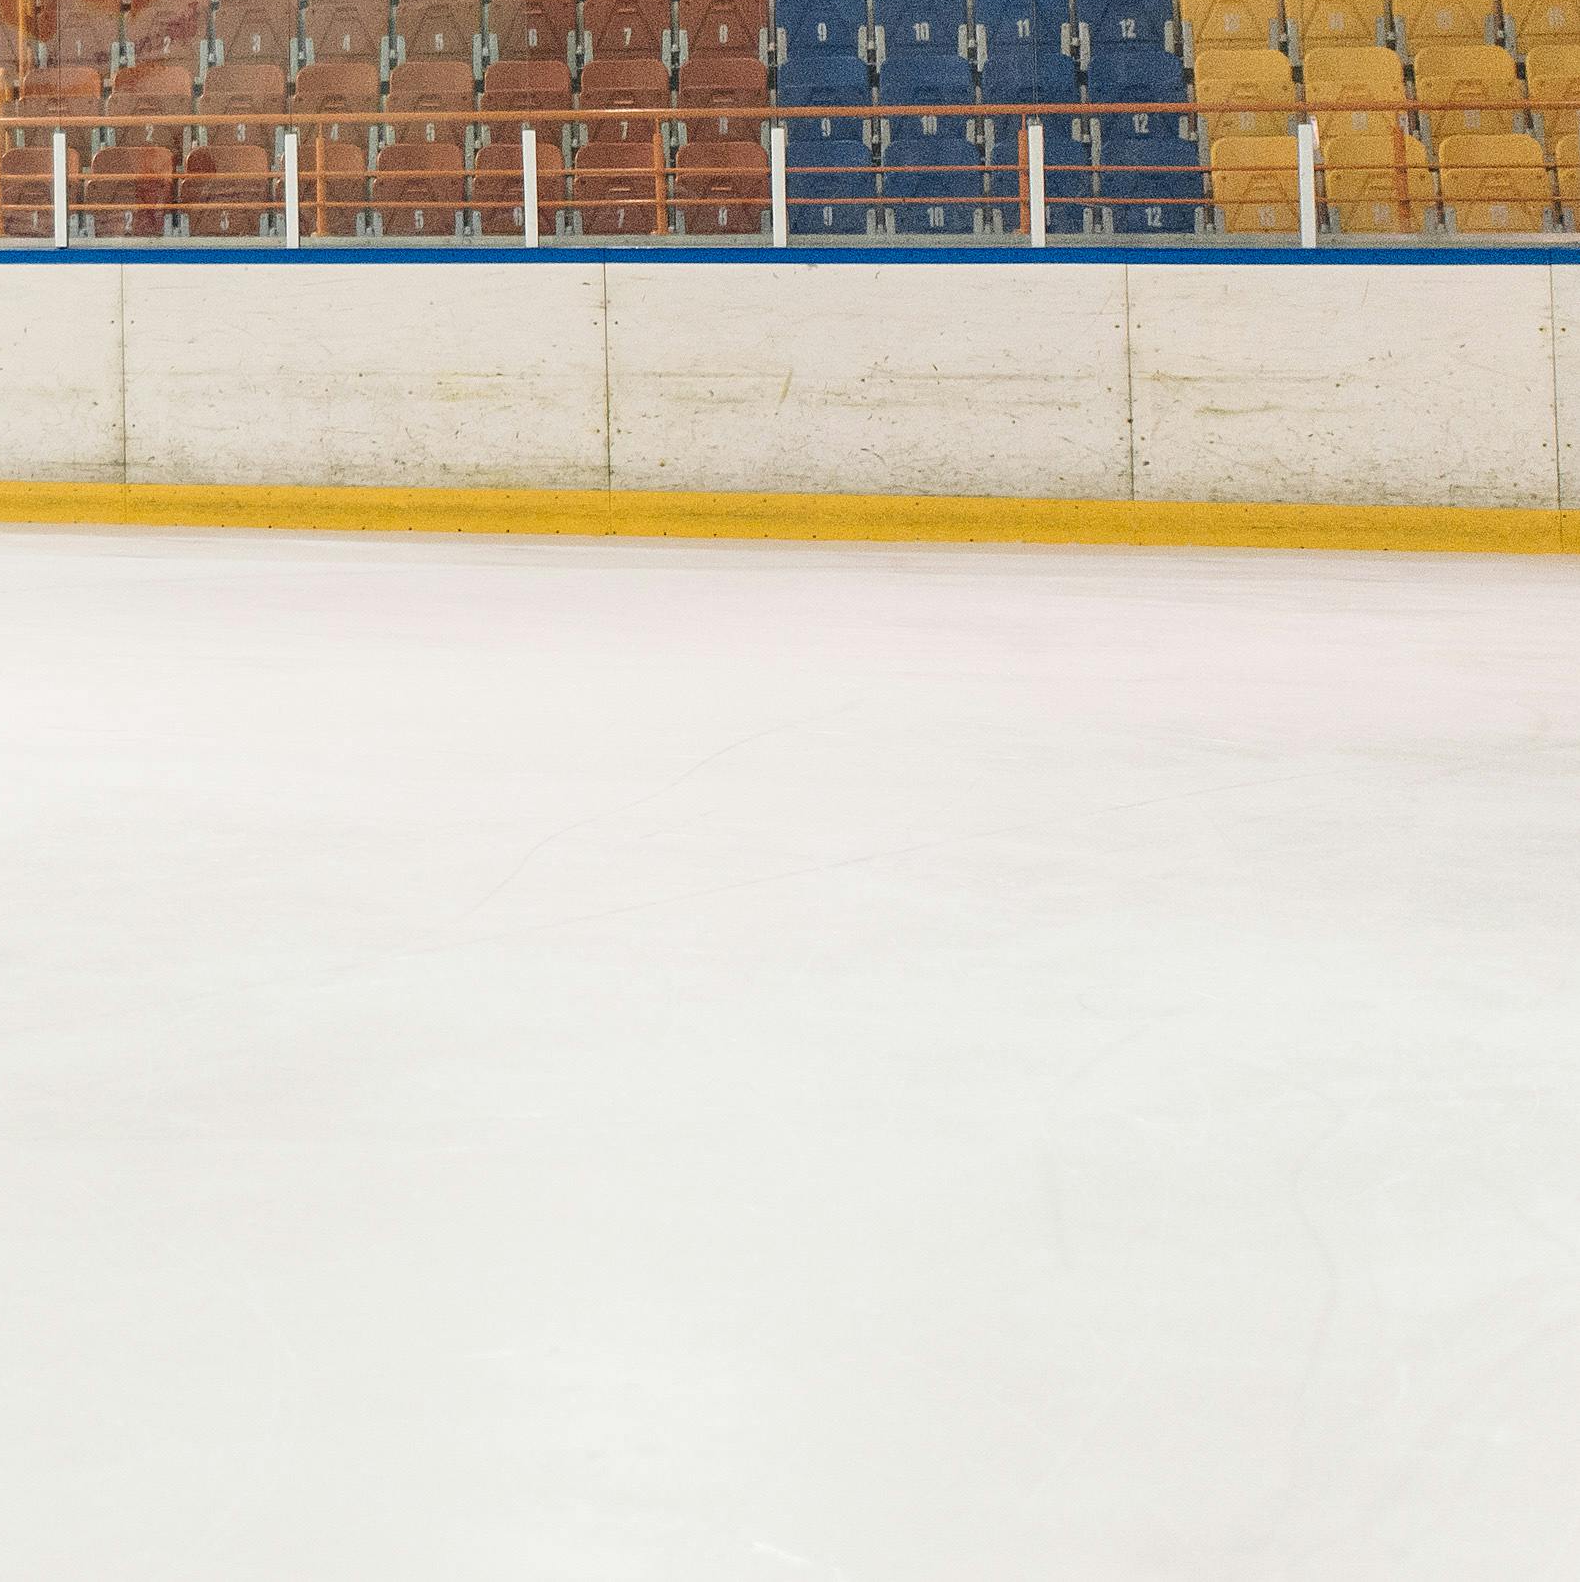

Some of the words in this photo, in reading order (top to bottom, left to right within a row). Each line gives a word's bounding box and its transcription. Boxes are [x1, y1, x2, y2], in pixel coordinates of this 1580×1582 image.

[624, 28, 631, 45] 7
[719, 25, 728, 43] 8
[817, 23, 827, 41] 9
[913, 22, 929, 40] 10
[1017, 19, 1030, 37] 11
[1120, 19, 1136, 38] 12
[821, 118, 831, 136] 9
[921, 115, 937, 133] 10
[1133, 113, 1148, 133] 12
[514, 210, 524, 227] 6
[718, 208, 727, 225] 8
[823, 206, 833, 226] 9
